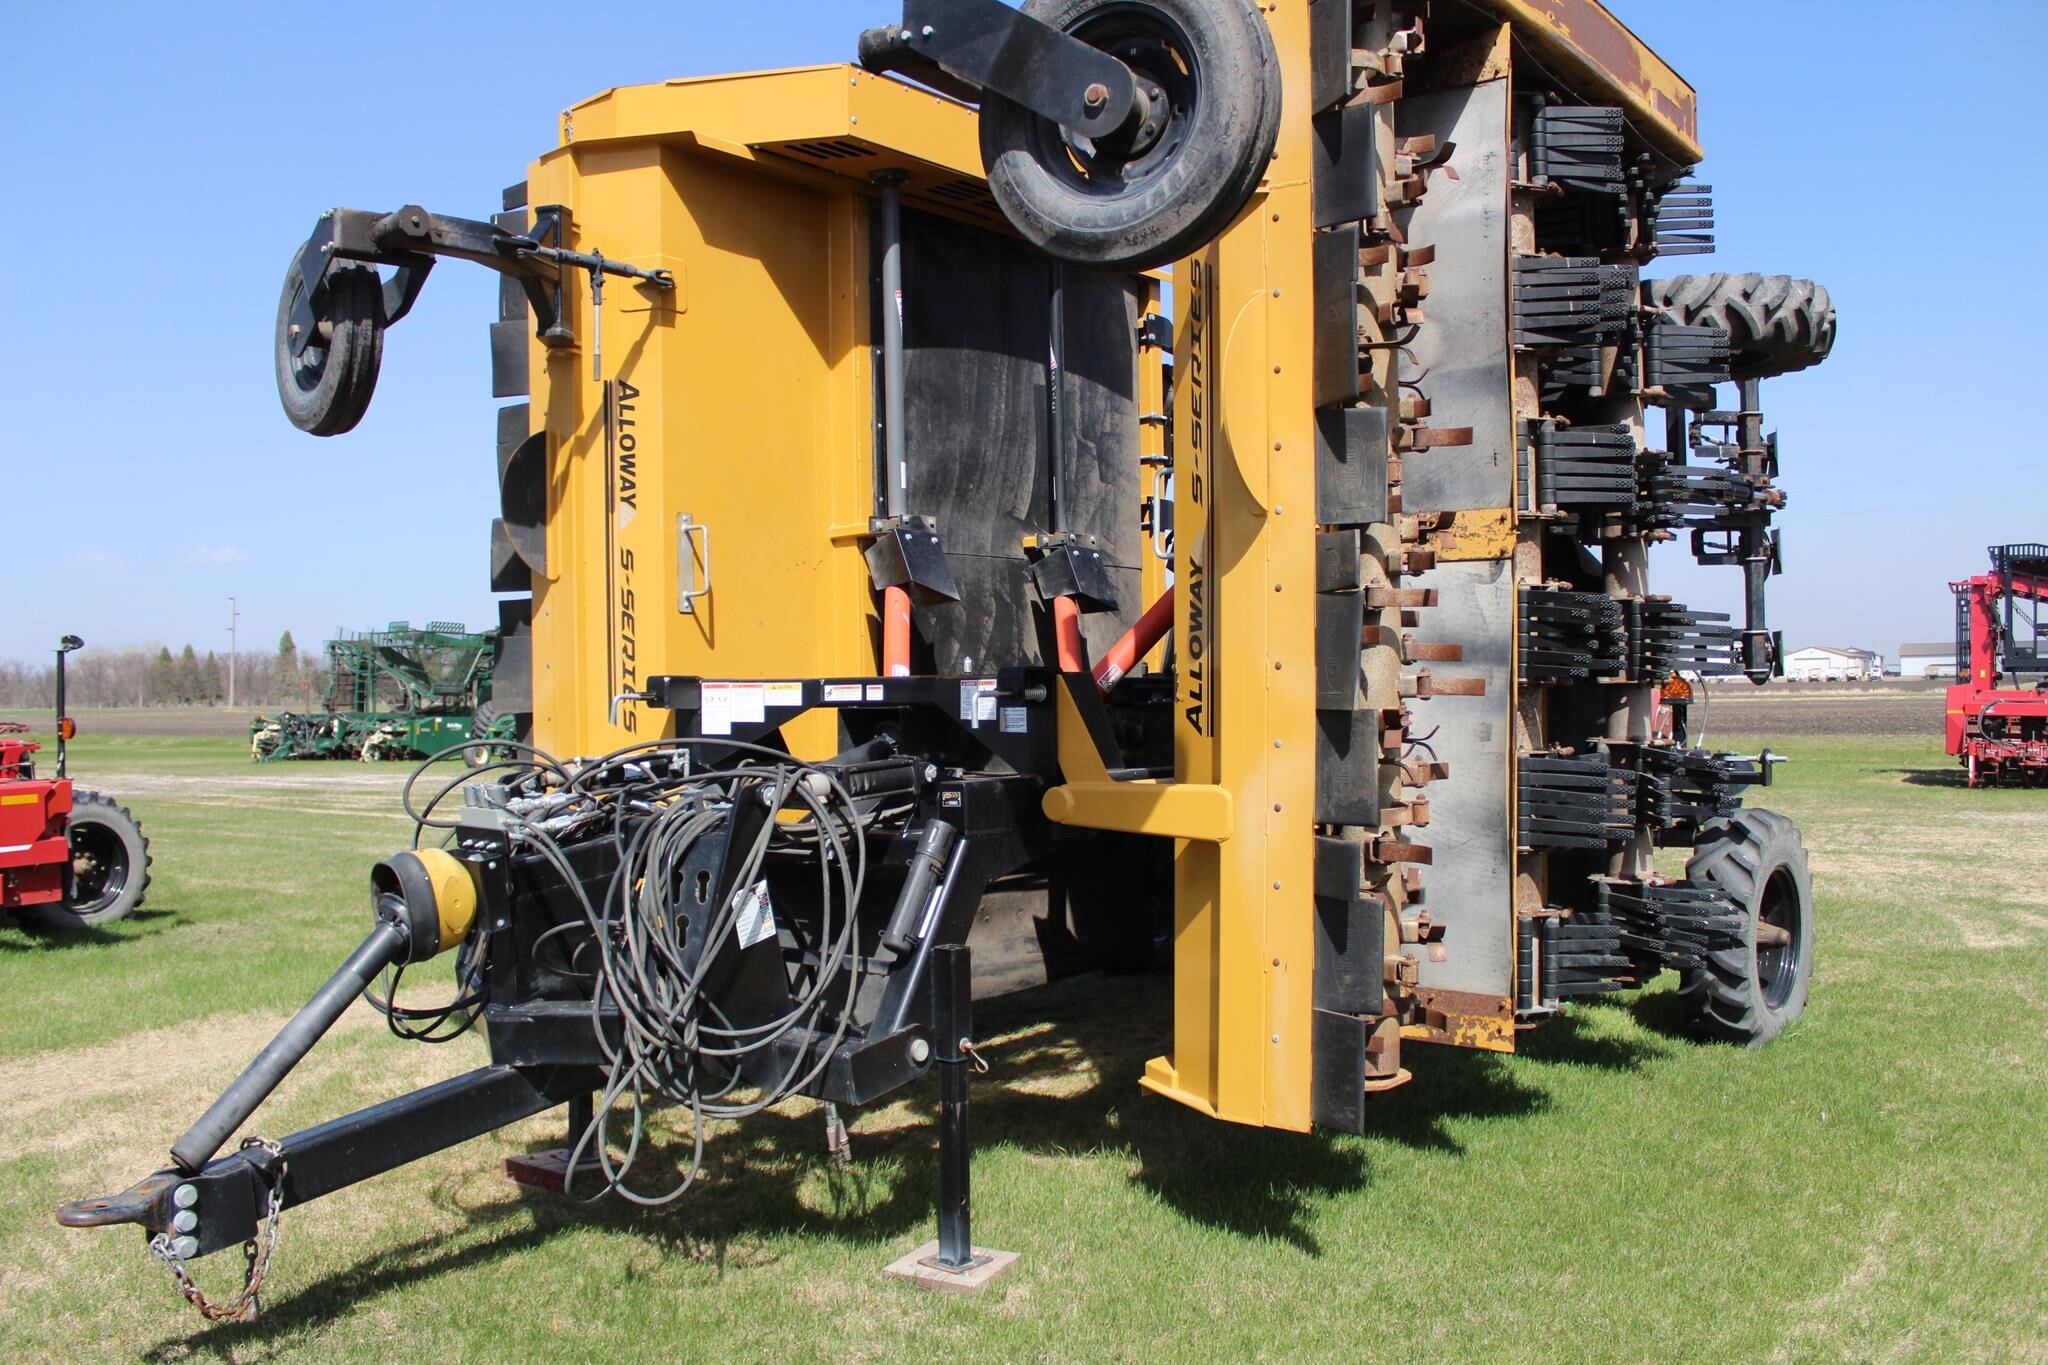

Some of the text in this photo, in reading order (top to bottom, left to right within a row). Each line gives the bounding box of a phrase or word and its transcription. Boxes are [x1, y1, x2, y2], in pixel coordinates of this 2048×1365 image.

[618, 379, 640, 736] ALLOWAY S-SERIES
[1186, 257, 1203, 737] ALLOWAY S-SERIES
